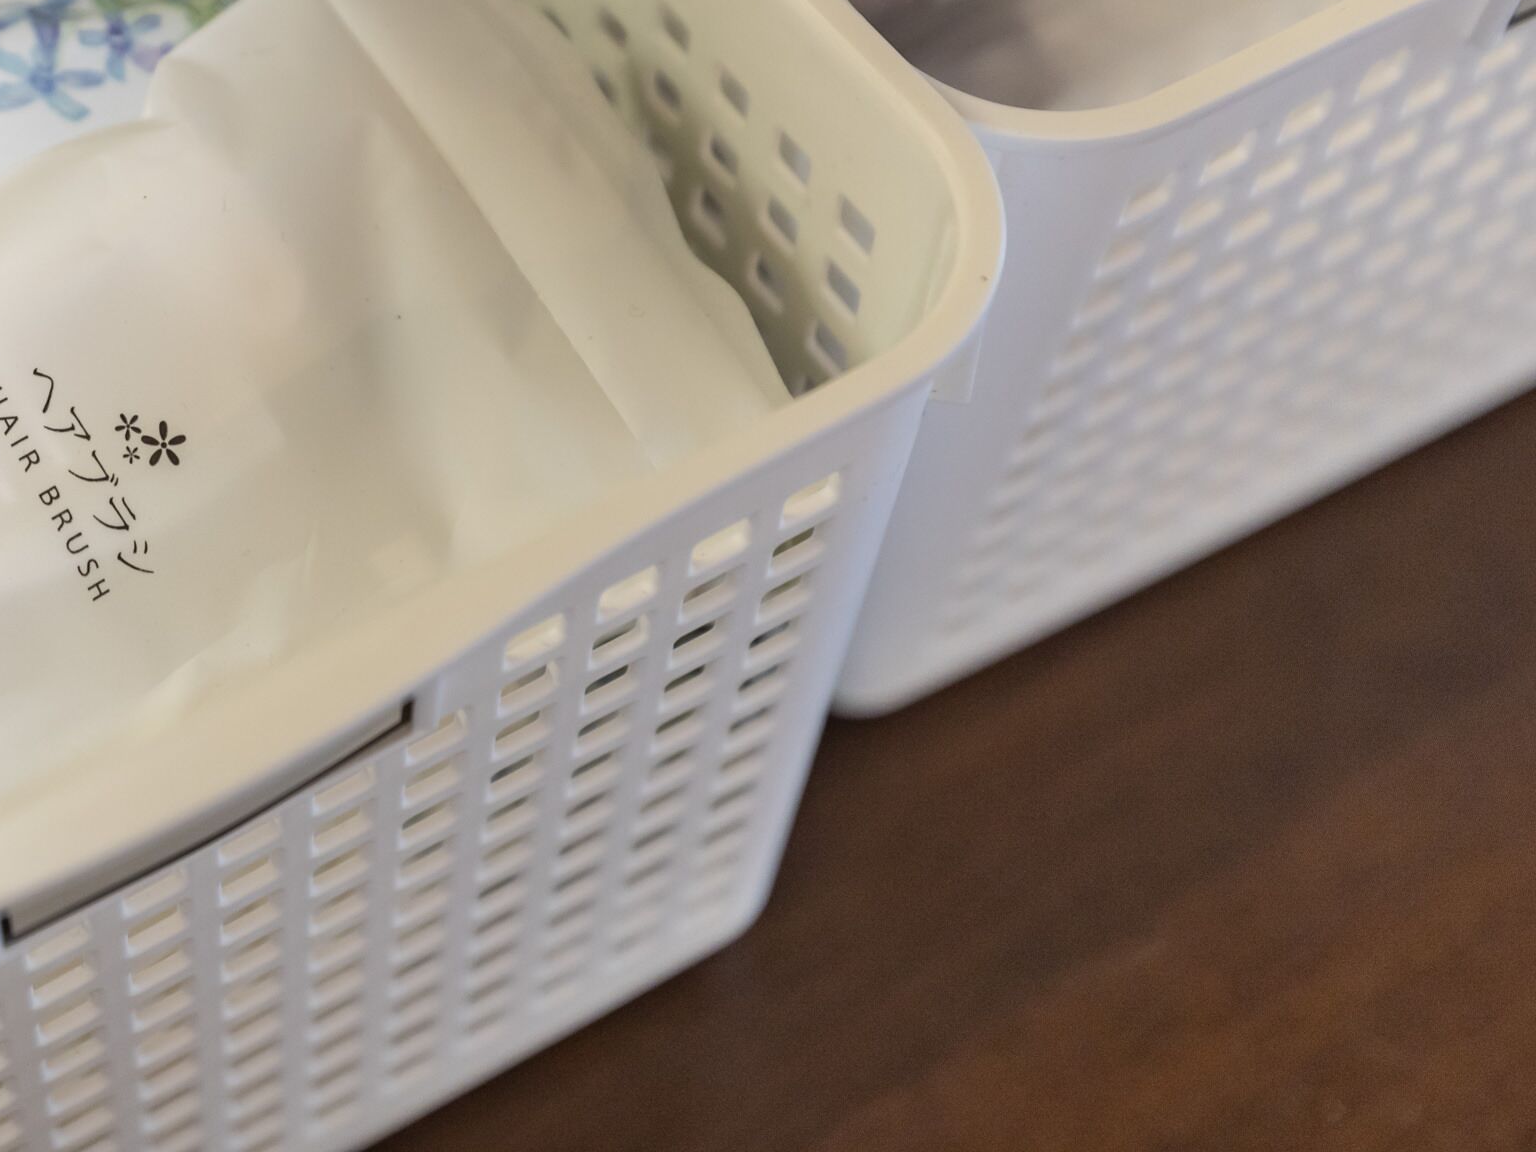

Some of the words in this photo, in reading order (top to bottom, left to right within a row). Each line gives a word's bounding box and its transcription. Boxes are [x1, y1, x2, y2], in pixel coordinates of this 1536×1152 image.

[32, 367, 155, 574] ヘアブラシ
[38, 485, 111, 602] BRUSH
